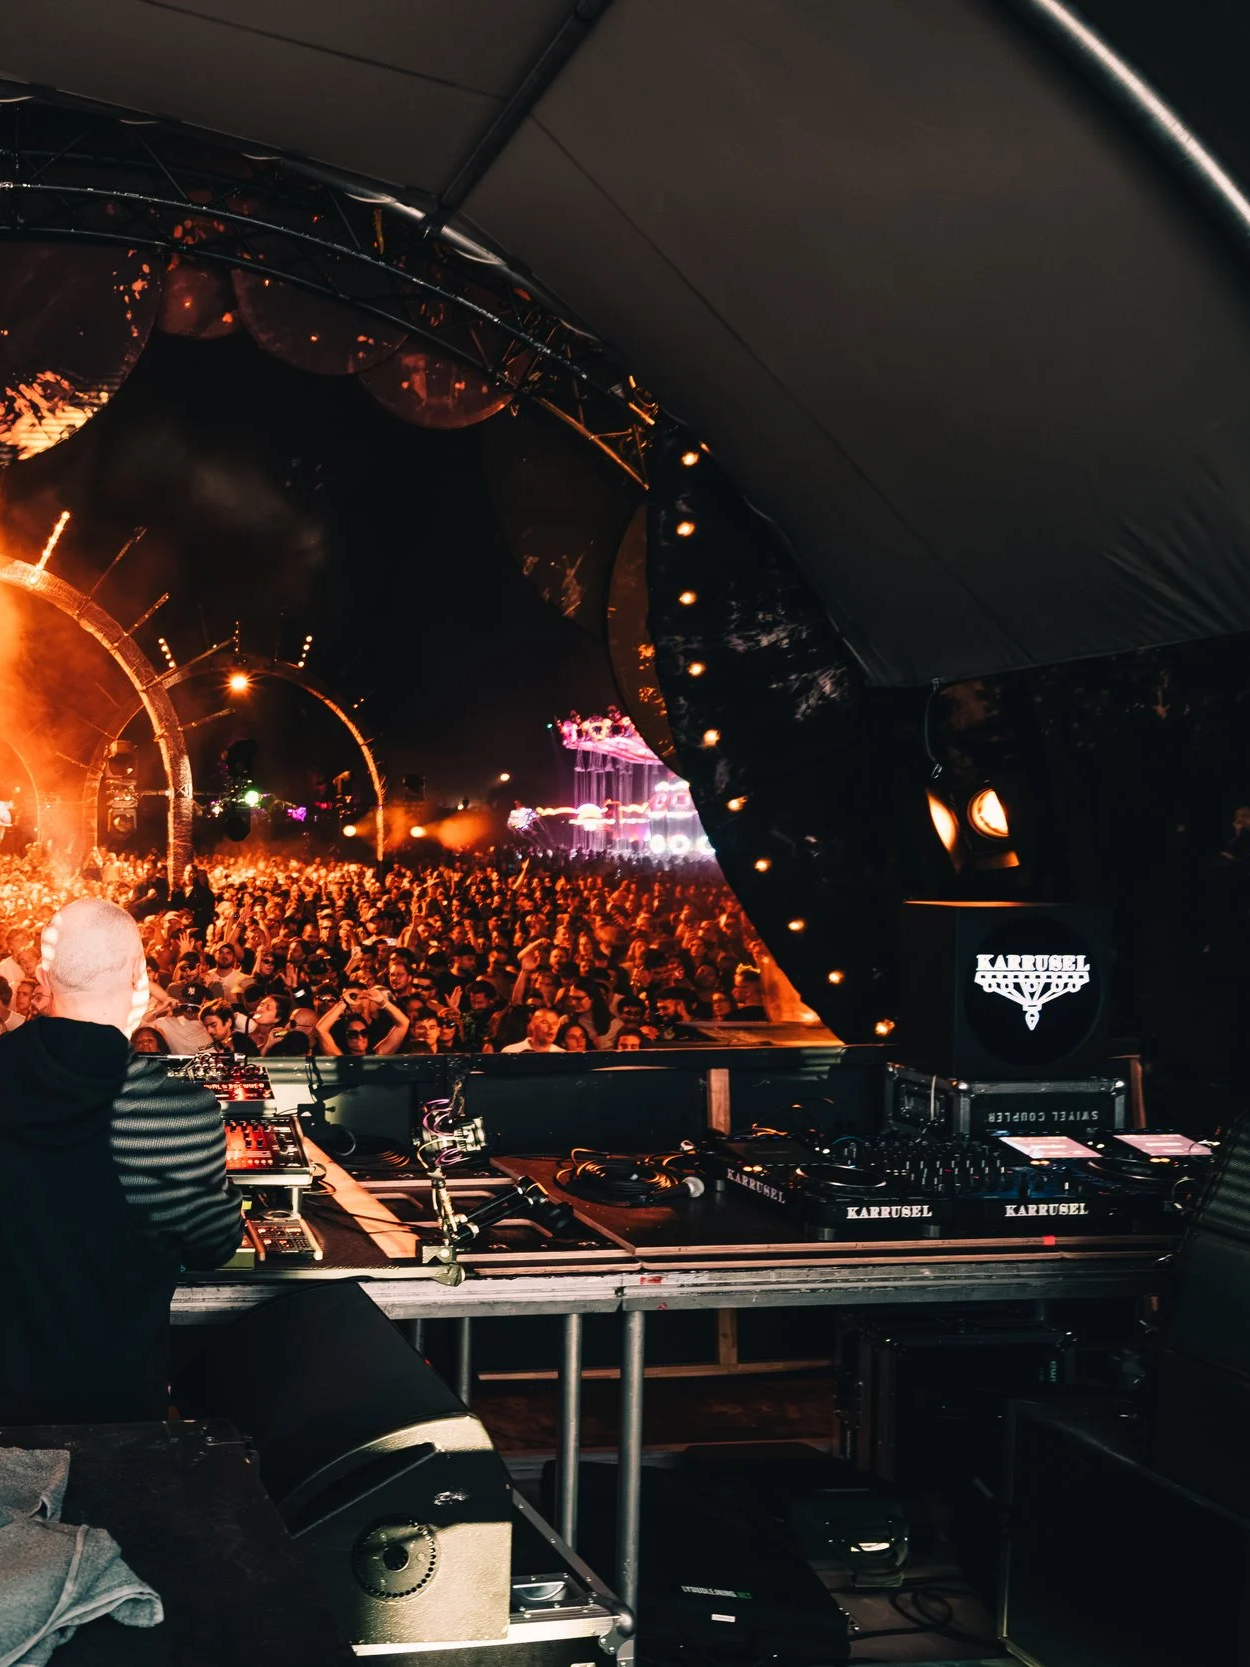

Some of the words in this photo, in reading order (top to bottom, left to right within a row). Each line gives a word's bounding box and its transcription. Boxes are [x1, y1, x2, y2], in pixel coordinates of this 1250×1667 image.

[976, 954, 1090, 971] KARRUSEL
[987, 1111, 1046, 1122] COUPLER
[727, 1164, 785, 1204] KARRUSEL
[846, 1205, 933, 1219] KARRUSEL
[1005, 1202, 1089, 1217] KARRUSEL
